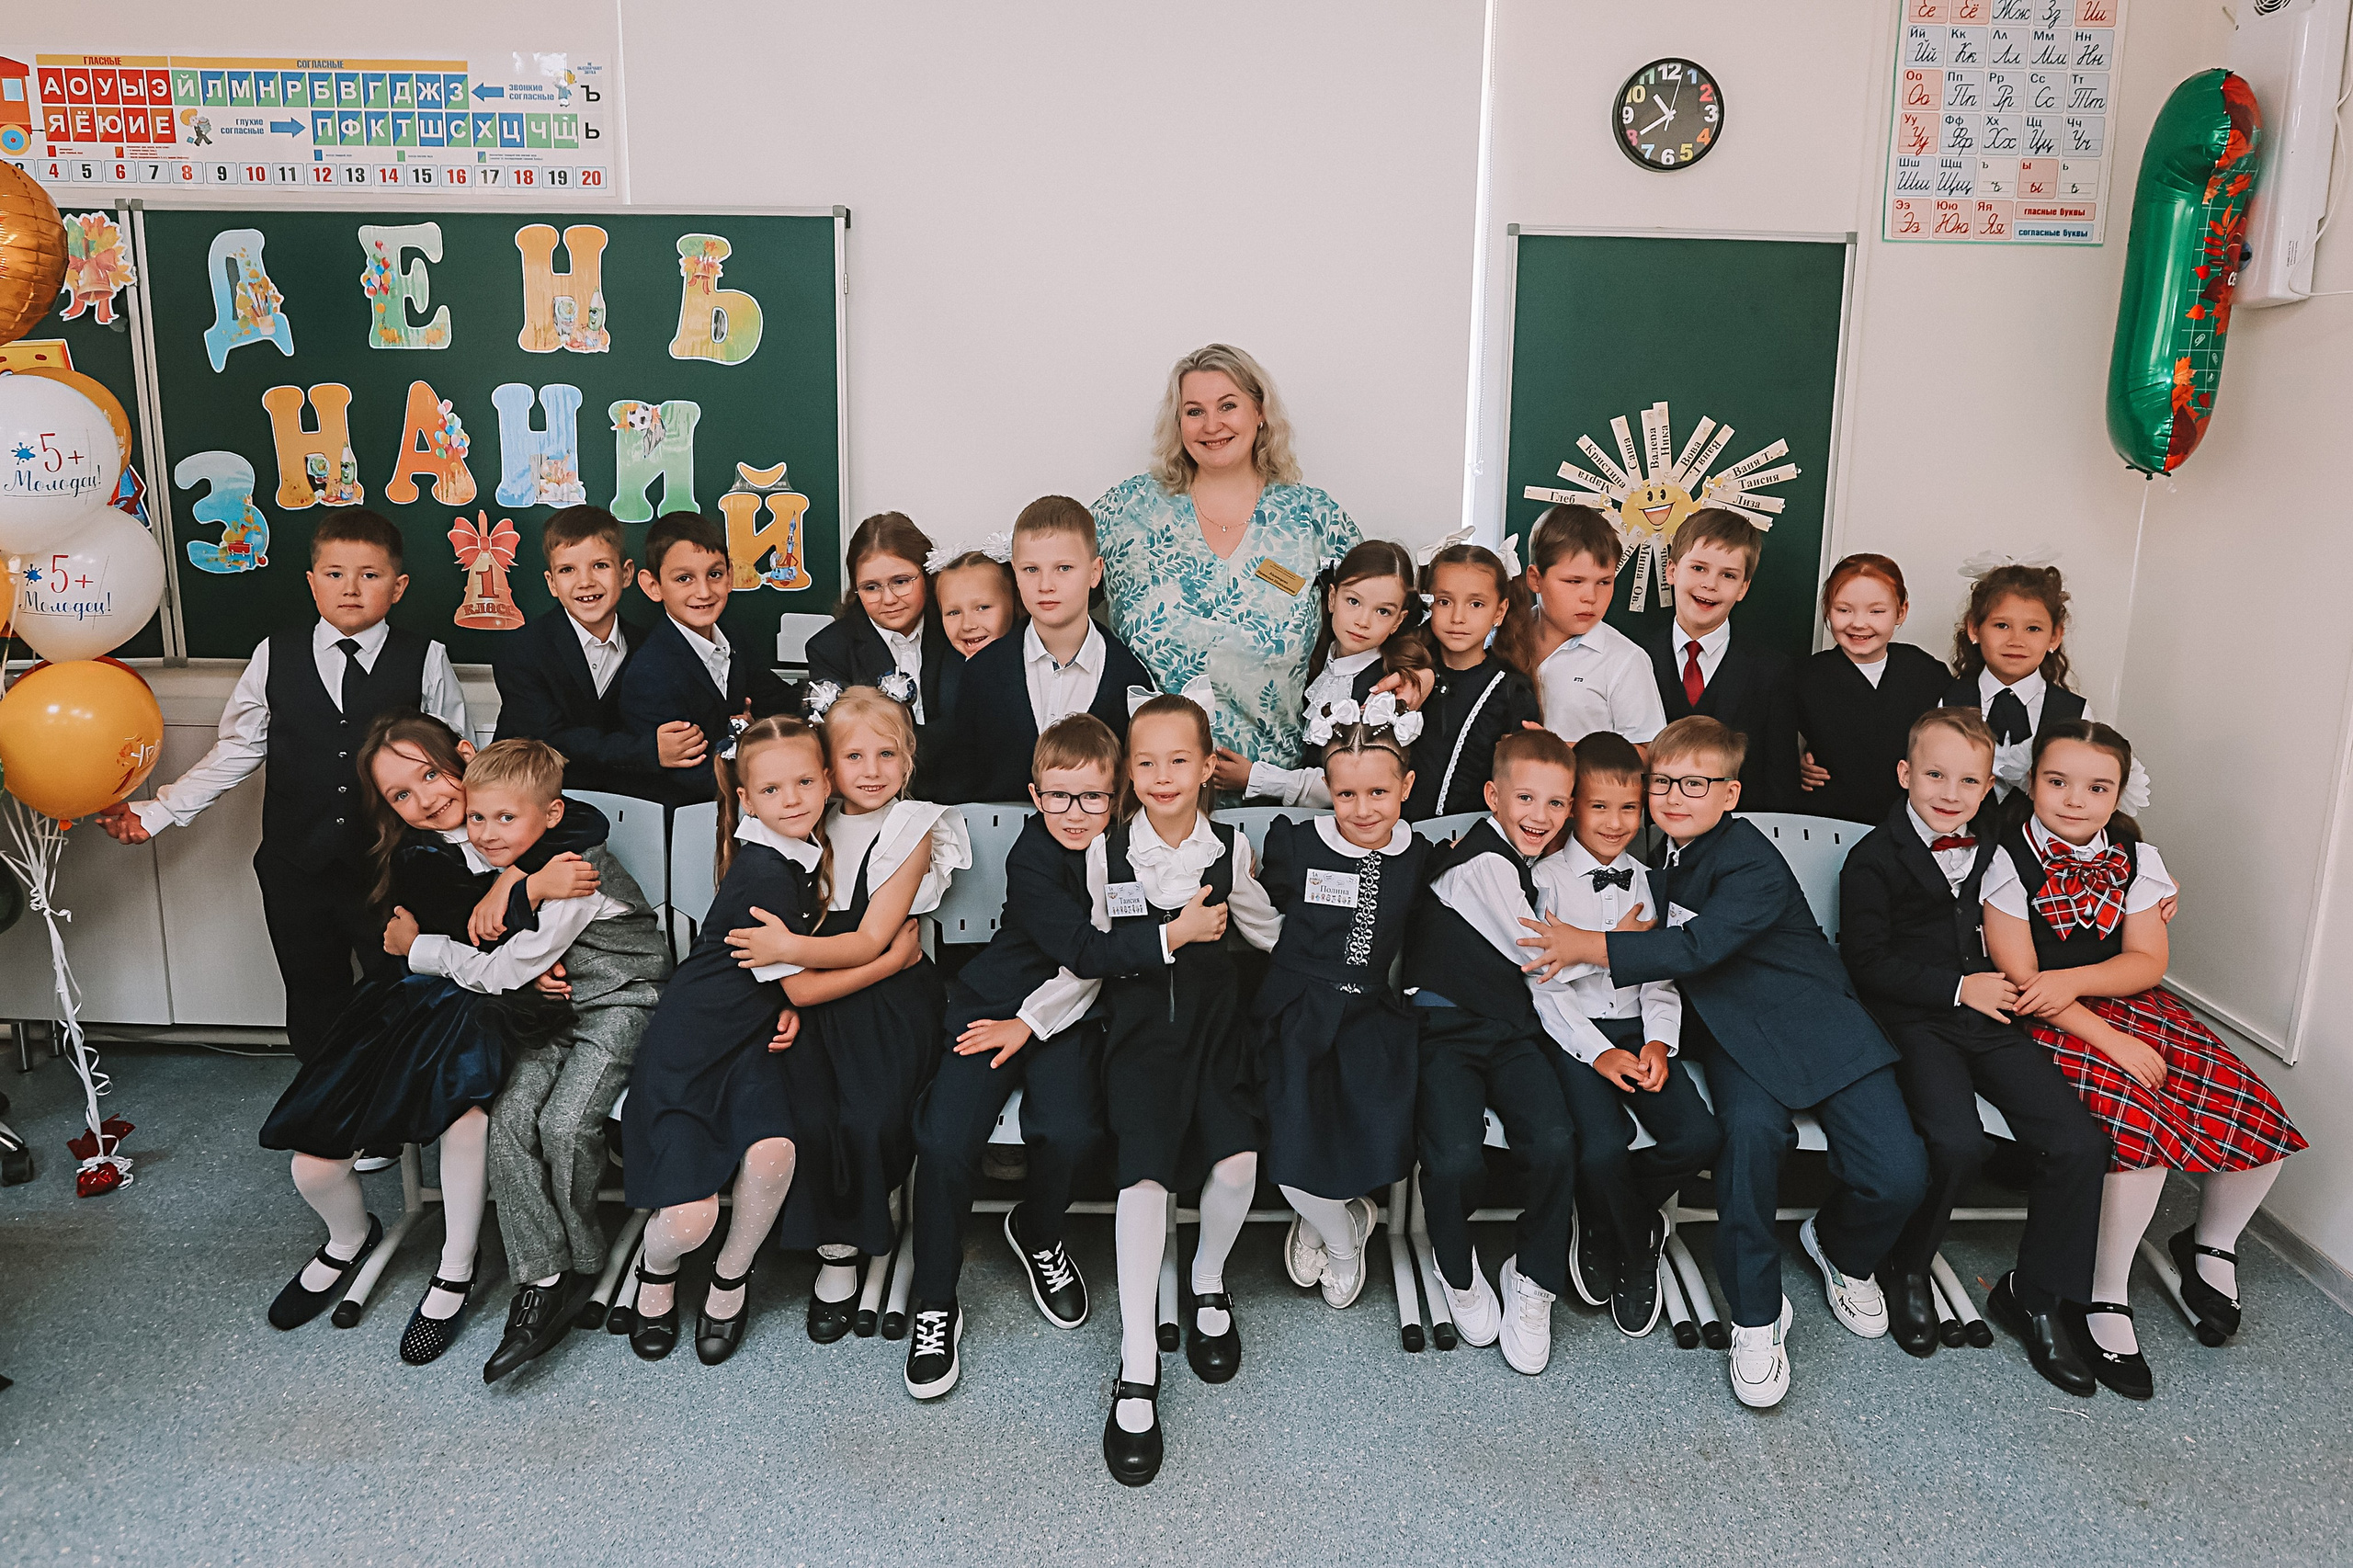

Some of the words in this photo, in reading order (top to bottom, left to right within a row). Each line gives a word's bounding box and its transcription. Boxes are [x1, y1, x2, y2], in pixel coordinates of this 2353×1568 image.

[2084, 1, 2107, 21] Ии
[1910, 27, 1926, 38] Йй
[1951, 29, 1966, 39] Кк
[1993, 30, 2007, 39] Лл
[2034, 32, 2054, 40] Мм
[2075, 32, 2091, 40] Нн
[84, 56, 121, 65] ГЛАСНЫЕ
[1915, 40, 1937, 62] Йй
[1956, 43, 1977, 62] Кк
[1993, 44, 2020, 64] Лл
[2031, 45, 2066, 64] Мм
[2077, 44, 2104, 65] Нн
[297, 60, 344, 69] СОГЛАСНЫЕ
[1658, 63, 1681, 80] 12
[1640, 68, 1654, 84] 11
[1688, 69, 1698, 84] 1
[1906, 71, 1922, 81] Оо
[1948, 72, 1962, 81] Пп
[1990, 73, 2004, 84] Рр
[2030, 74, 2045, 83] Сс
[2072, 74, 2085, 84] Тт
[41, 77, 62, 96] А
[70, 77, 86, 97] О
[94, 78, 113, 97] У
[121, 79, 144, 97] Ы
[152, 78, 167, 97] Э
[177, 74, 195, 97] Й
[206, 80, 222, 98] Л
[233, 81, 250, 98] М
[259, 81, 276, 98] Н
[287, 82, 301, 99] Р
[313, 82, 330, 99] Б
[340, 82, 358, 100] В
[369, 82, 382, 100] Г
[394, 82, 412, 104] Д
[417, 83, 441, 101] Ж
[449, 83, 463, 101] З
[509, 84, 543, 92] звонкие
[581, 85, 601, 102] Ъ
[1627, 85, 1645, 103] 10
[1699, 84, 1713, 102] 2
[1909, 84, 1930, 105] Оо
[1949, 85, 1977, 107] Пп
[1993, 85, 2014, 113] Рр
[2035, 86, 2054, 108] Сс
[2068, 88, 2105, 108] Тт
[48, 115, 65, 132] Я
[76, 111, 92, 133] Ё
[99, 115, 122, 133] Ю
[129, 117, 145, 134] И
[156, 116, 171, 134] Е
[1622, 107, 1634, 124] 9
[1704, 105, 1718, 122] 3
[1904, 115, 1917, 127] Уу
[1945, 115, 1964, 127] Фф
[1986, 117, 1999, 125] Хх
[2027, 117, 2042, 128] Цц
[2068, 119, 2082, 127] Чч
[221, 127, 265, 135] согласные
[317, 119, 333, 136] П
[341, 119, 361, 137] Ф
[371, 119, 385, 137] К
[396, 119, 412, 137] Т
[419, 119, 443, 138] Ш
[450, 119, 466, 138] С
[477, 120, 494, 138] Х
[503, 120, 520, 142] Ц
[531, 121, 546, 139] Ч
[553, 122, 578, 142] Щ
[585, 123, 600, 140] Ь
[1697, 128, 1711, 145] 4
[1908, 127, 1929, 155] Уу
[1948, 127, 1973, 156] Фф
[1984, 128, 2017, 148] Хх
[2029, 130, 2054, 153] Цц
[2073, 131, 2091, 150] Чч
[1641, 144, 1654, 159] 7
[1661, 149, 1675, 165] 6
[1680, 143, 1693, 160] 5
[1899, 158, 1919, 166] Шш
[1941, 159, 1962, 169] Щщ
[49, 163, 59, 178] 4
[82, 164, 92, 178] 5
[116, 164, 125, 179] 6
[149, 165, 159, 179] 7
[182, 165, 192, 180] 8
[218, 165, 227, 180] 9
[246, 166, 266, 181] 10
[279, 167, 296, 181] 11
[313, 168, 332, 182] 12
[346, 168, 365, 183] 13
[380, 168, 399, 183] 14
[413, 168, 432, 183] 15
[447, 169, 466, 184] 16
[481, 169, 499, 184] 17
[515, 170, 533, 185] 18
[549, 170, 568, 185] 19
[582, 170, 601, 185] 20
[1897, 171, 1930, 190] Шш
[1937, 172, 1972, 195] Щщ
[1896, 201, 1910, 210] Ээ
[1937, 202, 1958, 210] Юю
[1978, 203, 1992, 211] Яя
[2060, 207, 2085, 217] буквы
[1900, 212, 1921, 233] Ээ
[1935, 213, 1969, 233] Юю
[1980, 213, 2005, 234] Яя
[2018, 229, 2060, 237] согласные
[2063, 229, 2087, 239] буквы
[204, 222, 764, 371] ДЕНЬ
[1649, 427, 1660, 469] Валера
[1660, 425, 1669, 456] Ника
[40, 433, 85, 472] 5+
[1623, 437, 1638, 470] Саша
[1679, 441, 1702, 467] Вова
[1698, 440, 1722, 466] Ваня
[1585, 443, 1626, 489] Кристина
[1732, 459, 1761, 477] Ваня
[1761, 451, 1774, 461] Т.
[5, 464, 101, 498] Молодец!
[1577, 471, 1612, 494] Марта
[1737, 474, 1779, 489] Таисия
[1550, 492, 1575, 504] Глеб
[1732, 494, 1761, 509] Лиза
[1636, 542, 1651, 579] Миша
[51, 555, 94, 594] 5+
[475, 564, 499, 598] 1
[1631, 586, 1643, 605] Ов.
[18, 592, 111, 620] Молодец!
[1320, 885, 1349, 895] Полина
